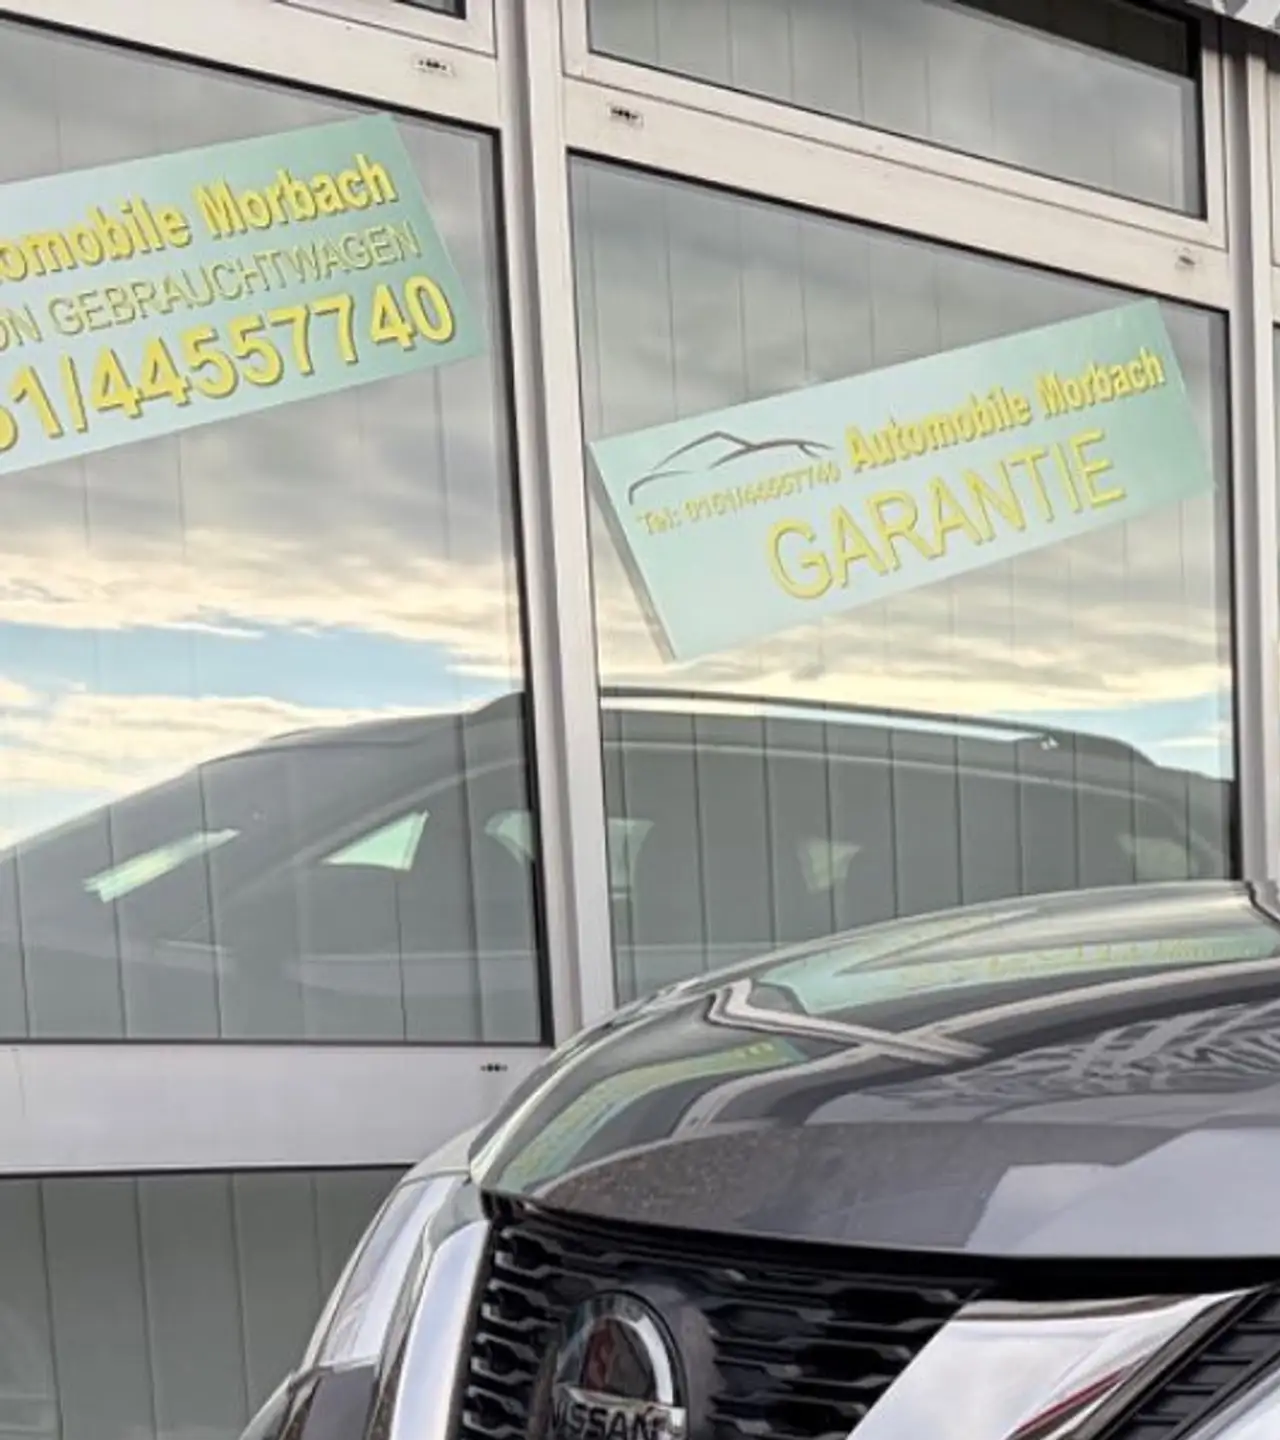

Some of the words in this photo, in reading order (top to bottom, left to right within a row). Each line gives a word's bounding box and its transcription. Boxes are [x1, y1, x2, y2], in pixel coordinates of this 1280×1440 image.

[0, 198, 193, 285] omobile
[198, 152, 400, 240] Morbach
[48, 220, 422, 336] GEBRAUCHTWAGEN
[845, 385, 1032, 474] Automobile
[1035, 346, 1167, 420] Morbach
[766, 428, 1127, 600] GARANTIE
